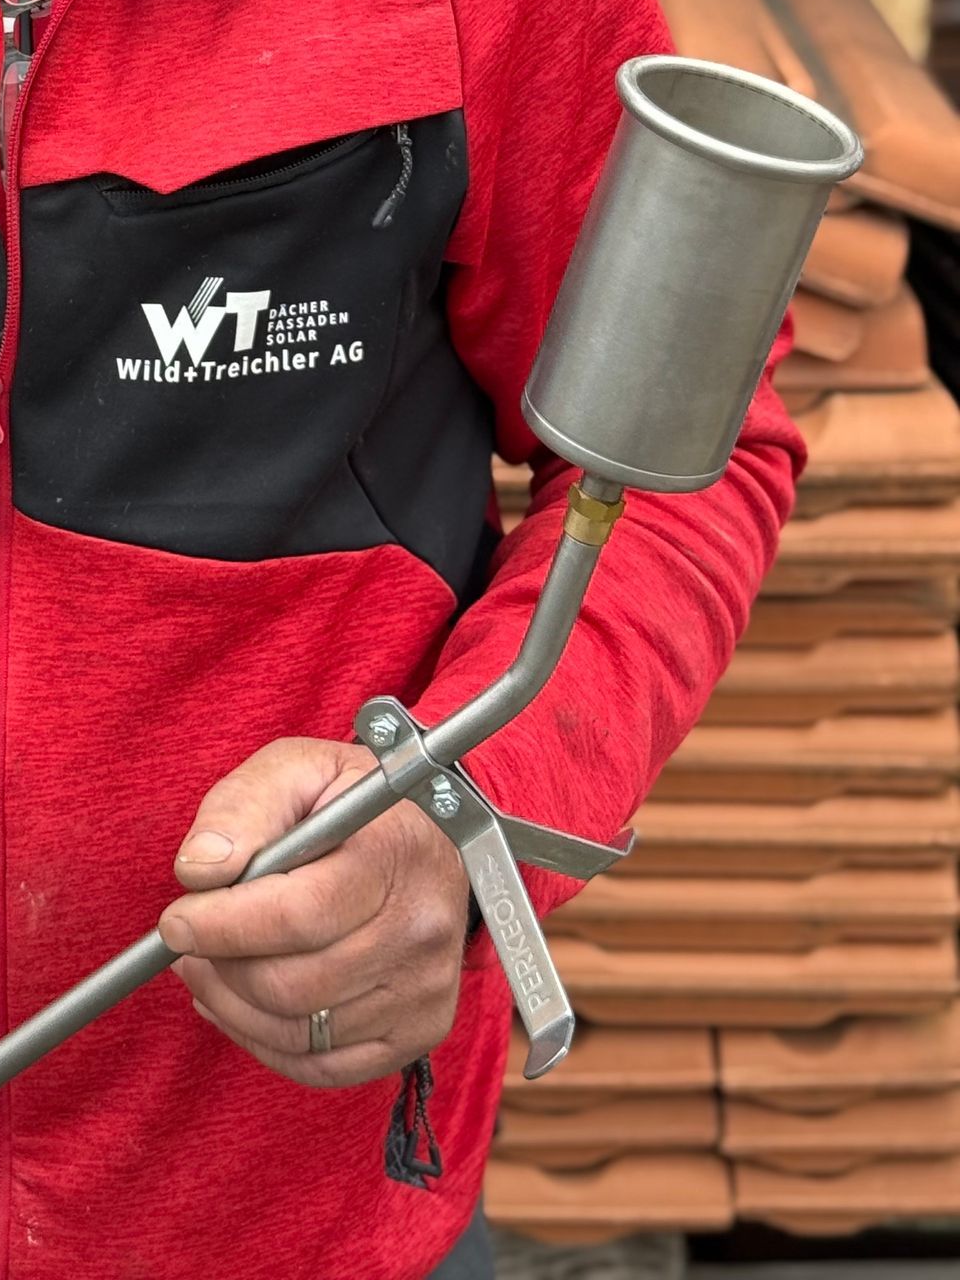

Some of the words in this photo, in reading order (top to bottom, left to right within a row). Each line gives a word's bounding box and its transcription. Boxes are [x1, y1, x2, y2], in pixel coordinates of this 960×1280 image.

[269, 300, 329, 320] DÄCHER
[267, 311, 350, 333] FASSADEN
[266, 329, 318, 346] SOLAR
[116, 349, 320, 383] Wild+Treichler
[330, 341, 364, 366] AG
[490, 897, 549, 1015] PERKEO
